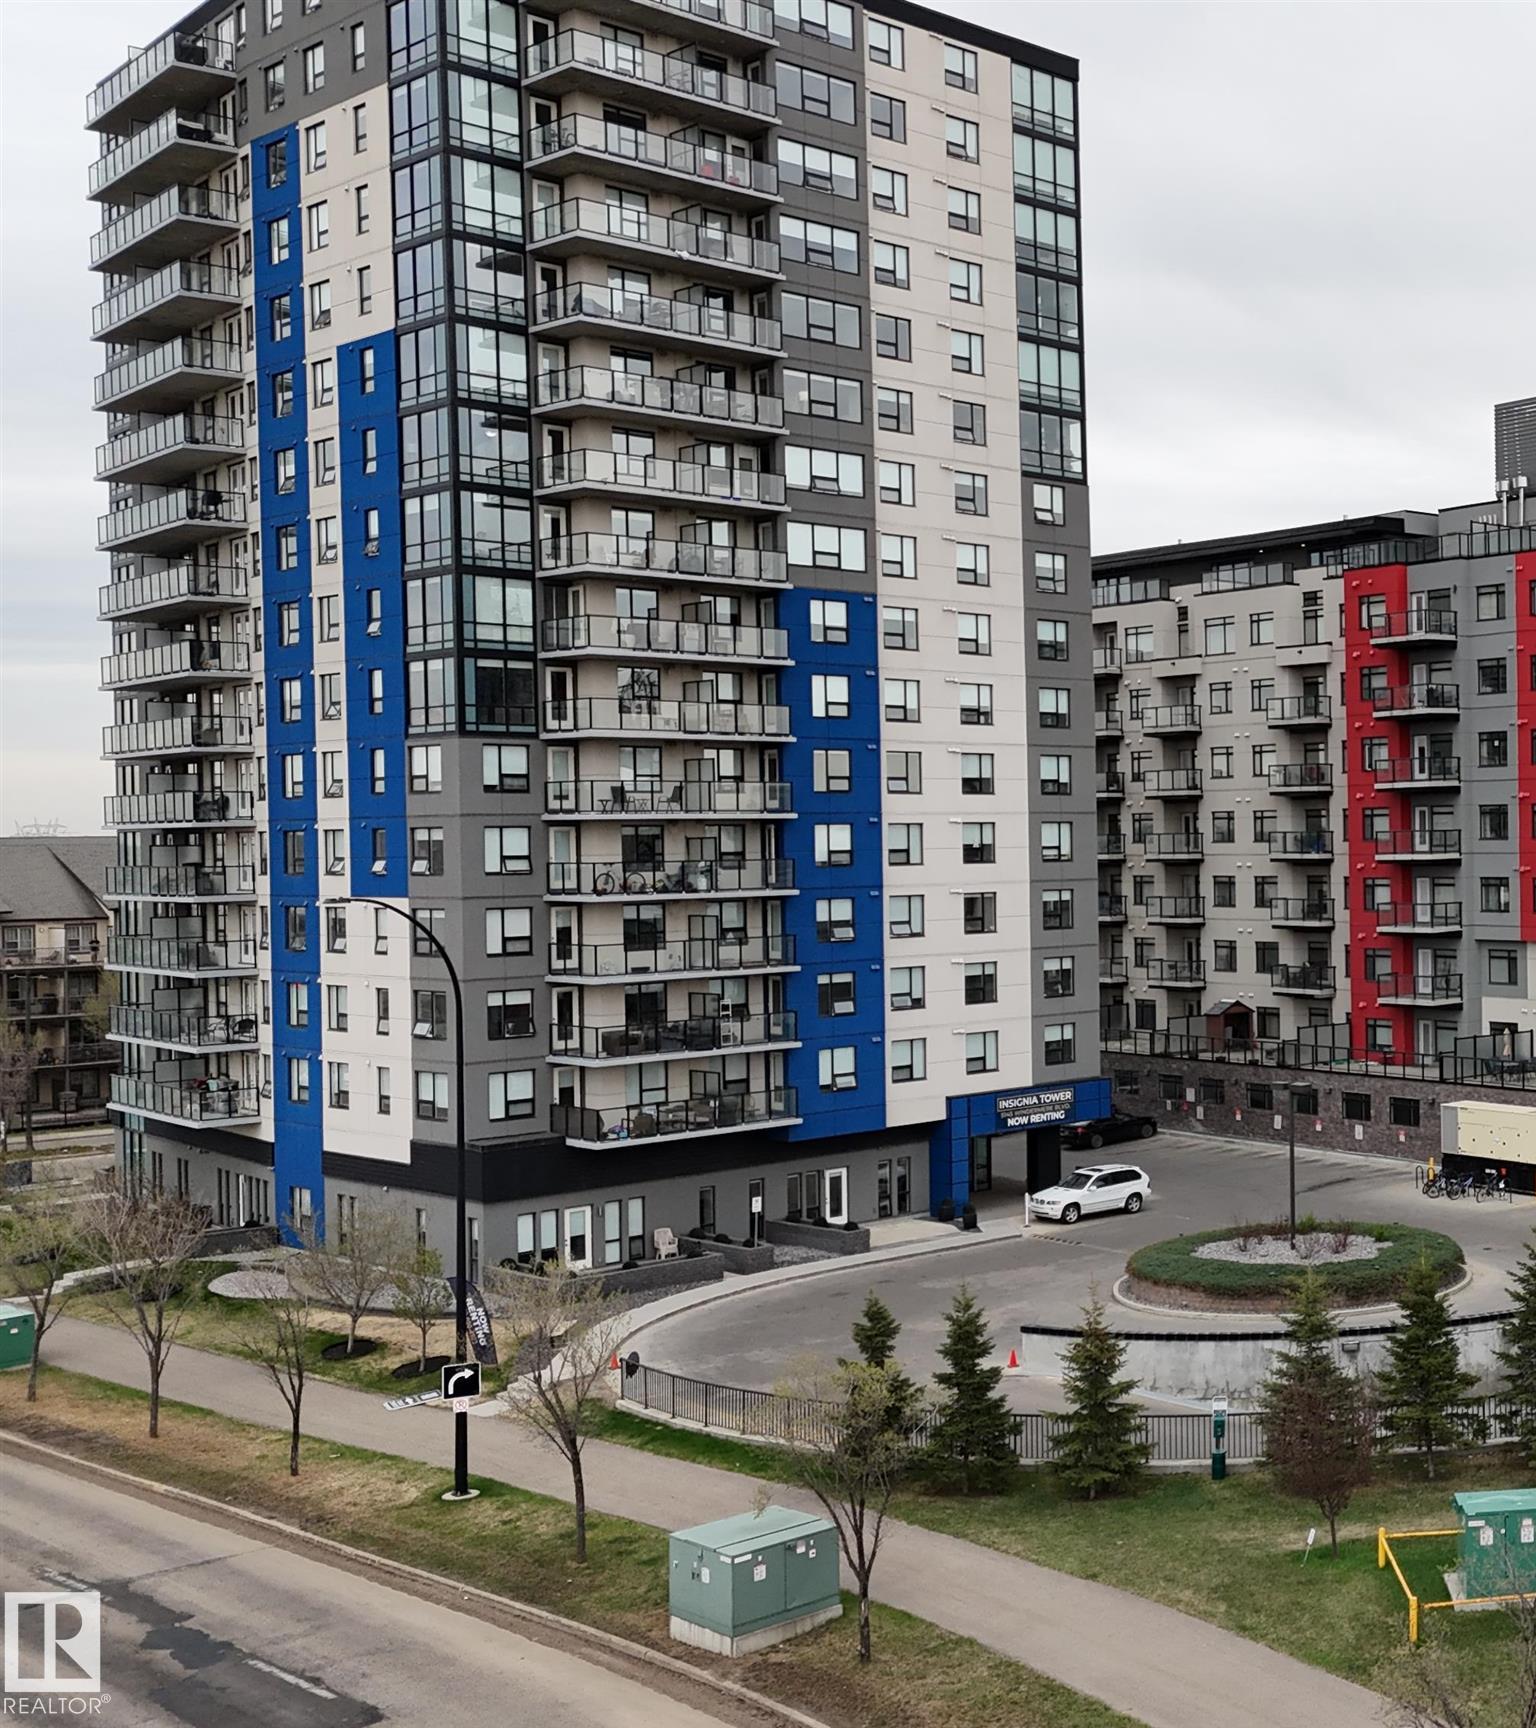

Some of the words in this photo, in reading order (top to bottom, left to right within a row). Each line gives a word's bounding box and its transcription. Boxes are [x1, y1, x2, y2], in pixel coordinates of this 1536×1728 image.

[999, 1096, 1039, 1109] INSIGNIA
[1039, 1091, 1072, 1103] TOWER
[1007, 1115, 1030, 1127] NOW
[1030, 1110, 1065, 1124] RENTING
[465, 1297, 488, 1346] RENTING
[476, 1307, 490, 1334] NOW
